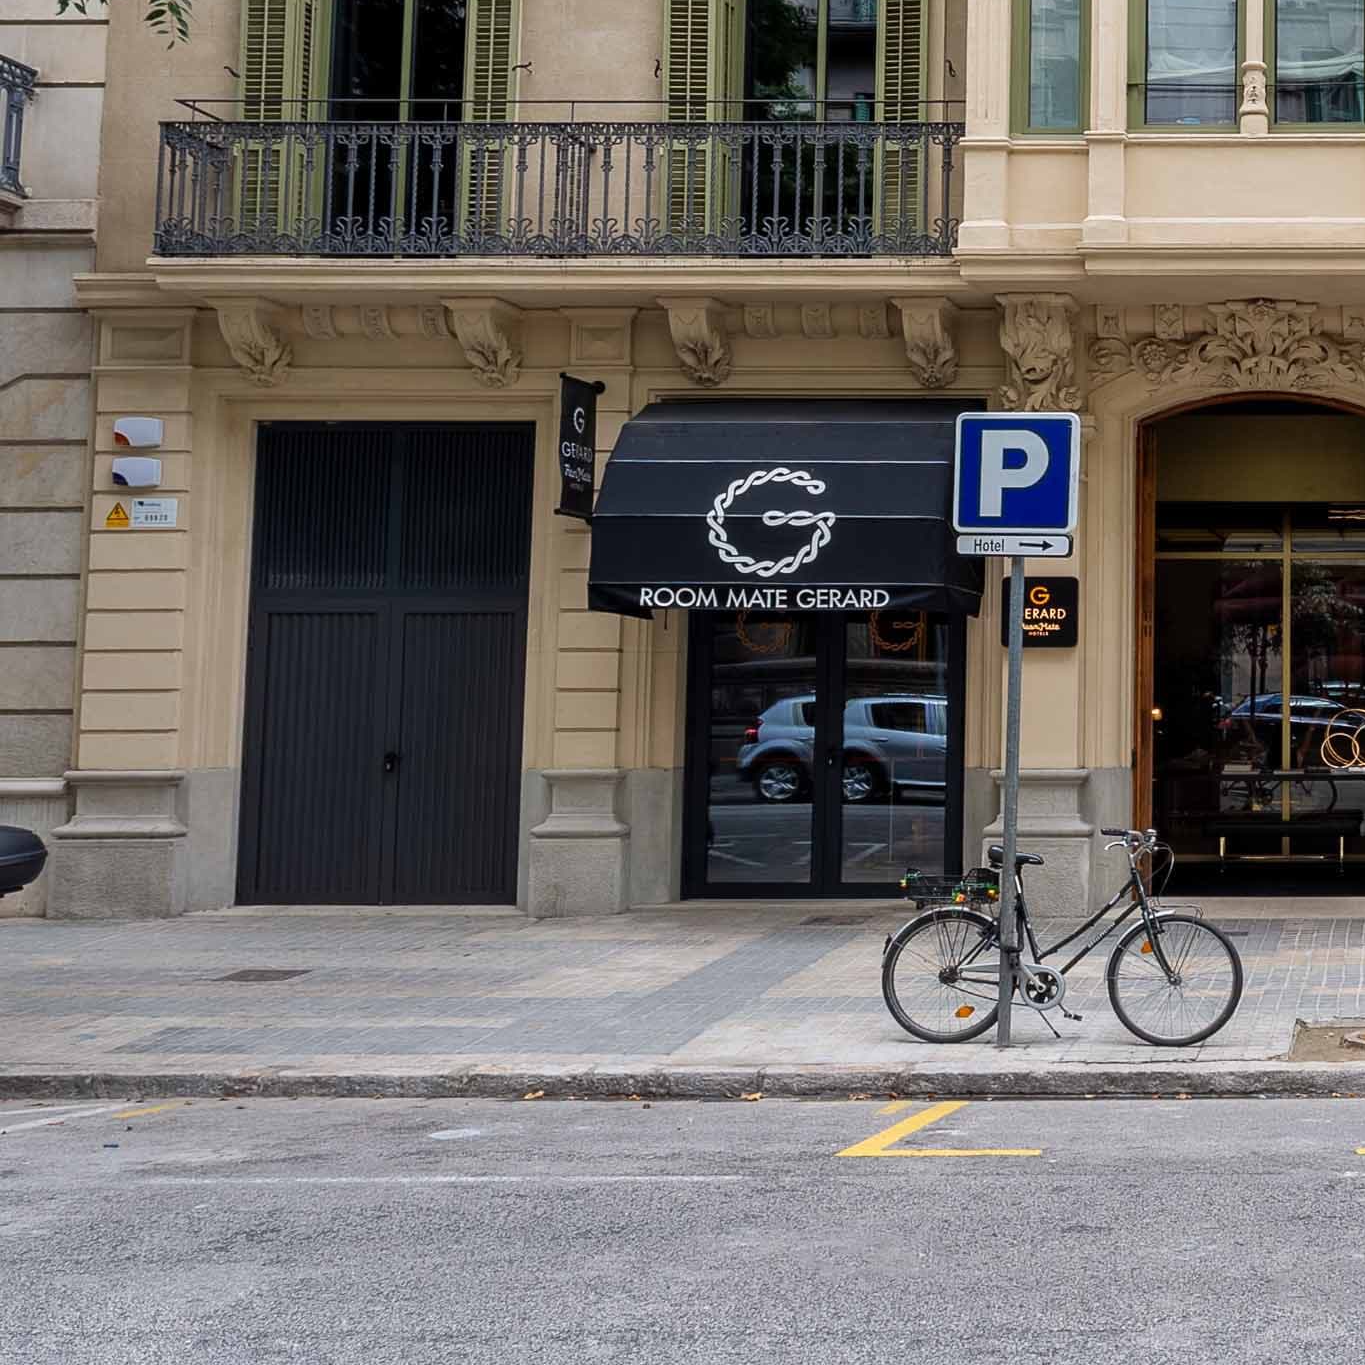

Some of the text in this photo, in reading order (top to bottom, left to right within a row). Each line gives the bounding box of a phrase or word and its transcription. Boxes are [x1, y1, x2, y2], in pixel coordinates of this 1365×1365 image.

[572, 406, 586, 434] G
[979, 429, 1050, 517] P
[706, 467, 836, 577] G
[973, 538, 1005, 553] Hotel
[639, 587, 891, 609] ROOM MATE GERARD
[1030, 586, 1050, 605] G
[1023, 608, 1067, 620] ERARD
